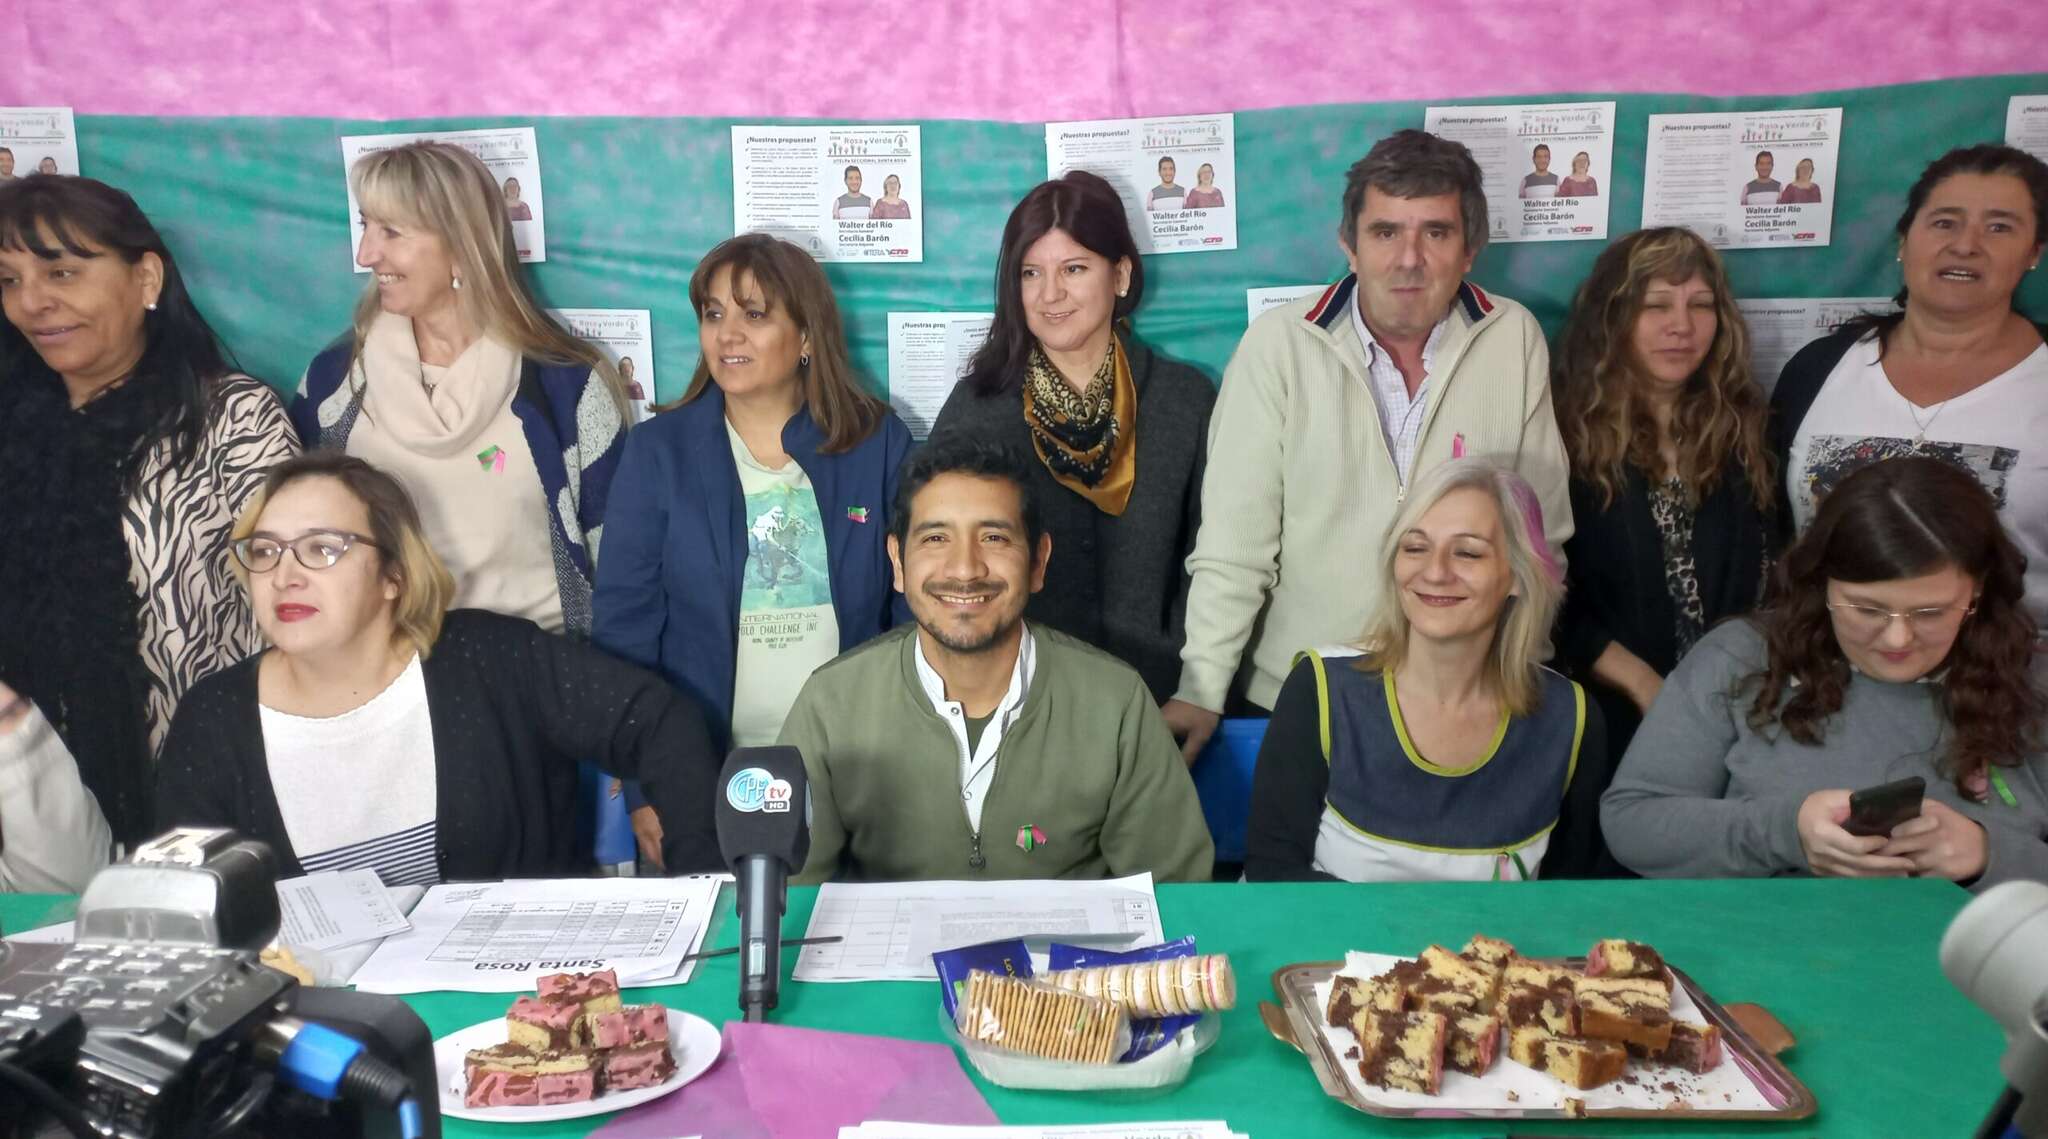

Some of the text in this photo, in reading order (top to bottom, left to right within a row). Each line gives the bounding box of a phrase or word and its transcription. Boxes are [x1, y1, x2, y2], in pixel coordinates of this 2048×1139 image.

[1060, 132, 1091, 140] ¿Nuestras
[1091, 129, 1130, 138] propuestas?
[746, 136, 817, 144] ¿Nuestras propuestas?
[869, 136, 892, 144] Verde
[1523, 200, 1550, 208] Walter
[1551, 199, 1564, 207] del
[1745, 206, 1772, 214] Walter
[1773, 206, 1786, 214] del
[1152, 211, 1178, 220] Walter
[1180, 210, 1192, 219] del
[1523, 212, 1575, 221] Cecilia Barón
[838, 221, 864, 229] Walter
[866, 221, 878, 229] del
[1745, 218, 1797, 228] Cecilia Barón
[1152, 223, 1204, 234] Cecilia Barón
[838, 234, 890, 242] Cecilia Barón
[602, 319, 624, 327] Verde
[902, 322, 932, 330] ¿Nuestras
[760, 622, 801, 635] CHALLENGE
[769, 787, 787, 799] tv
[474, 958, 606, 971] Santa Rosa
